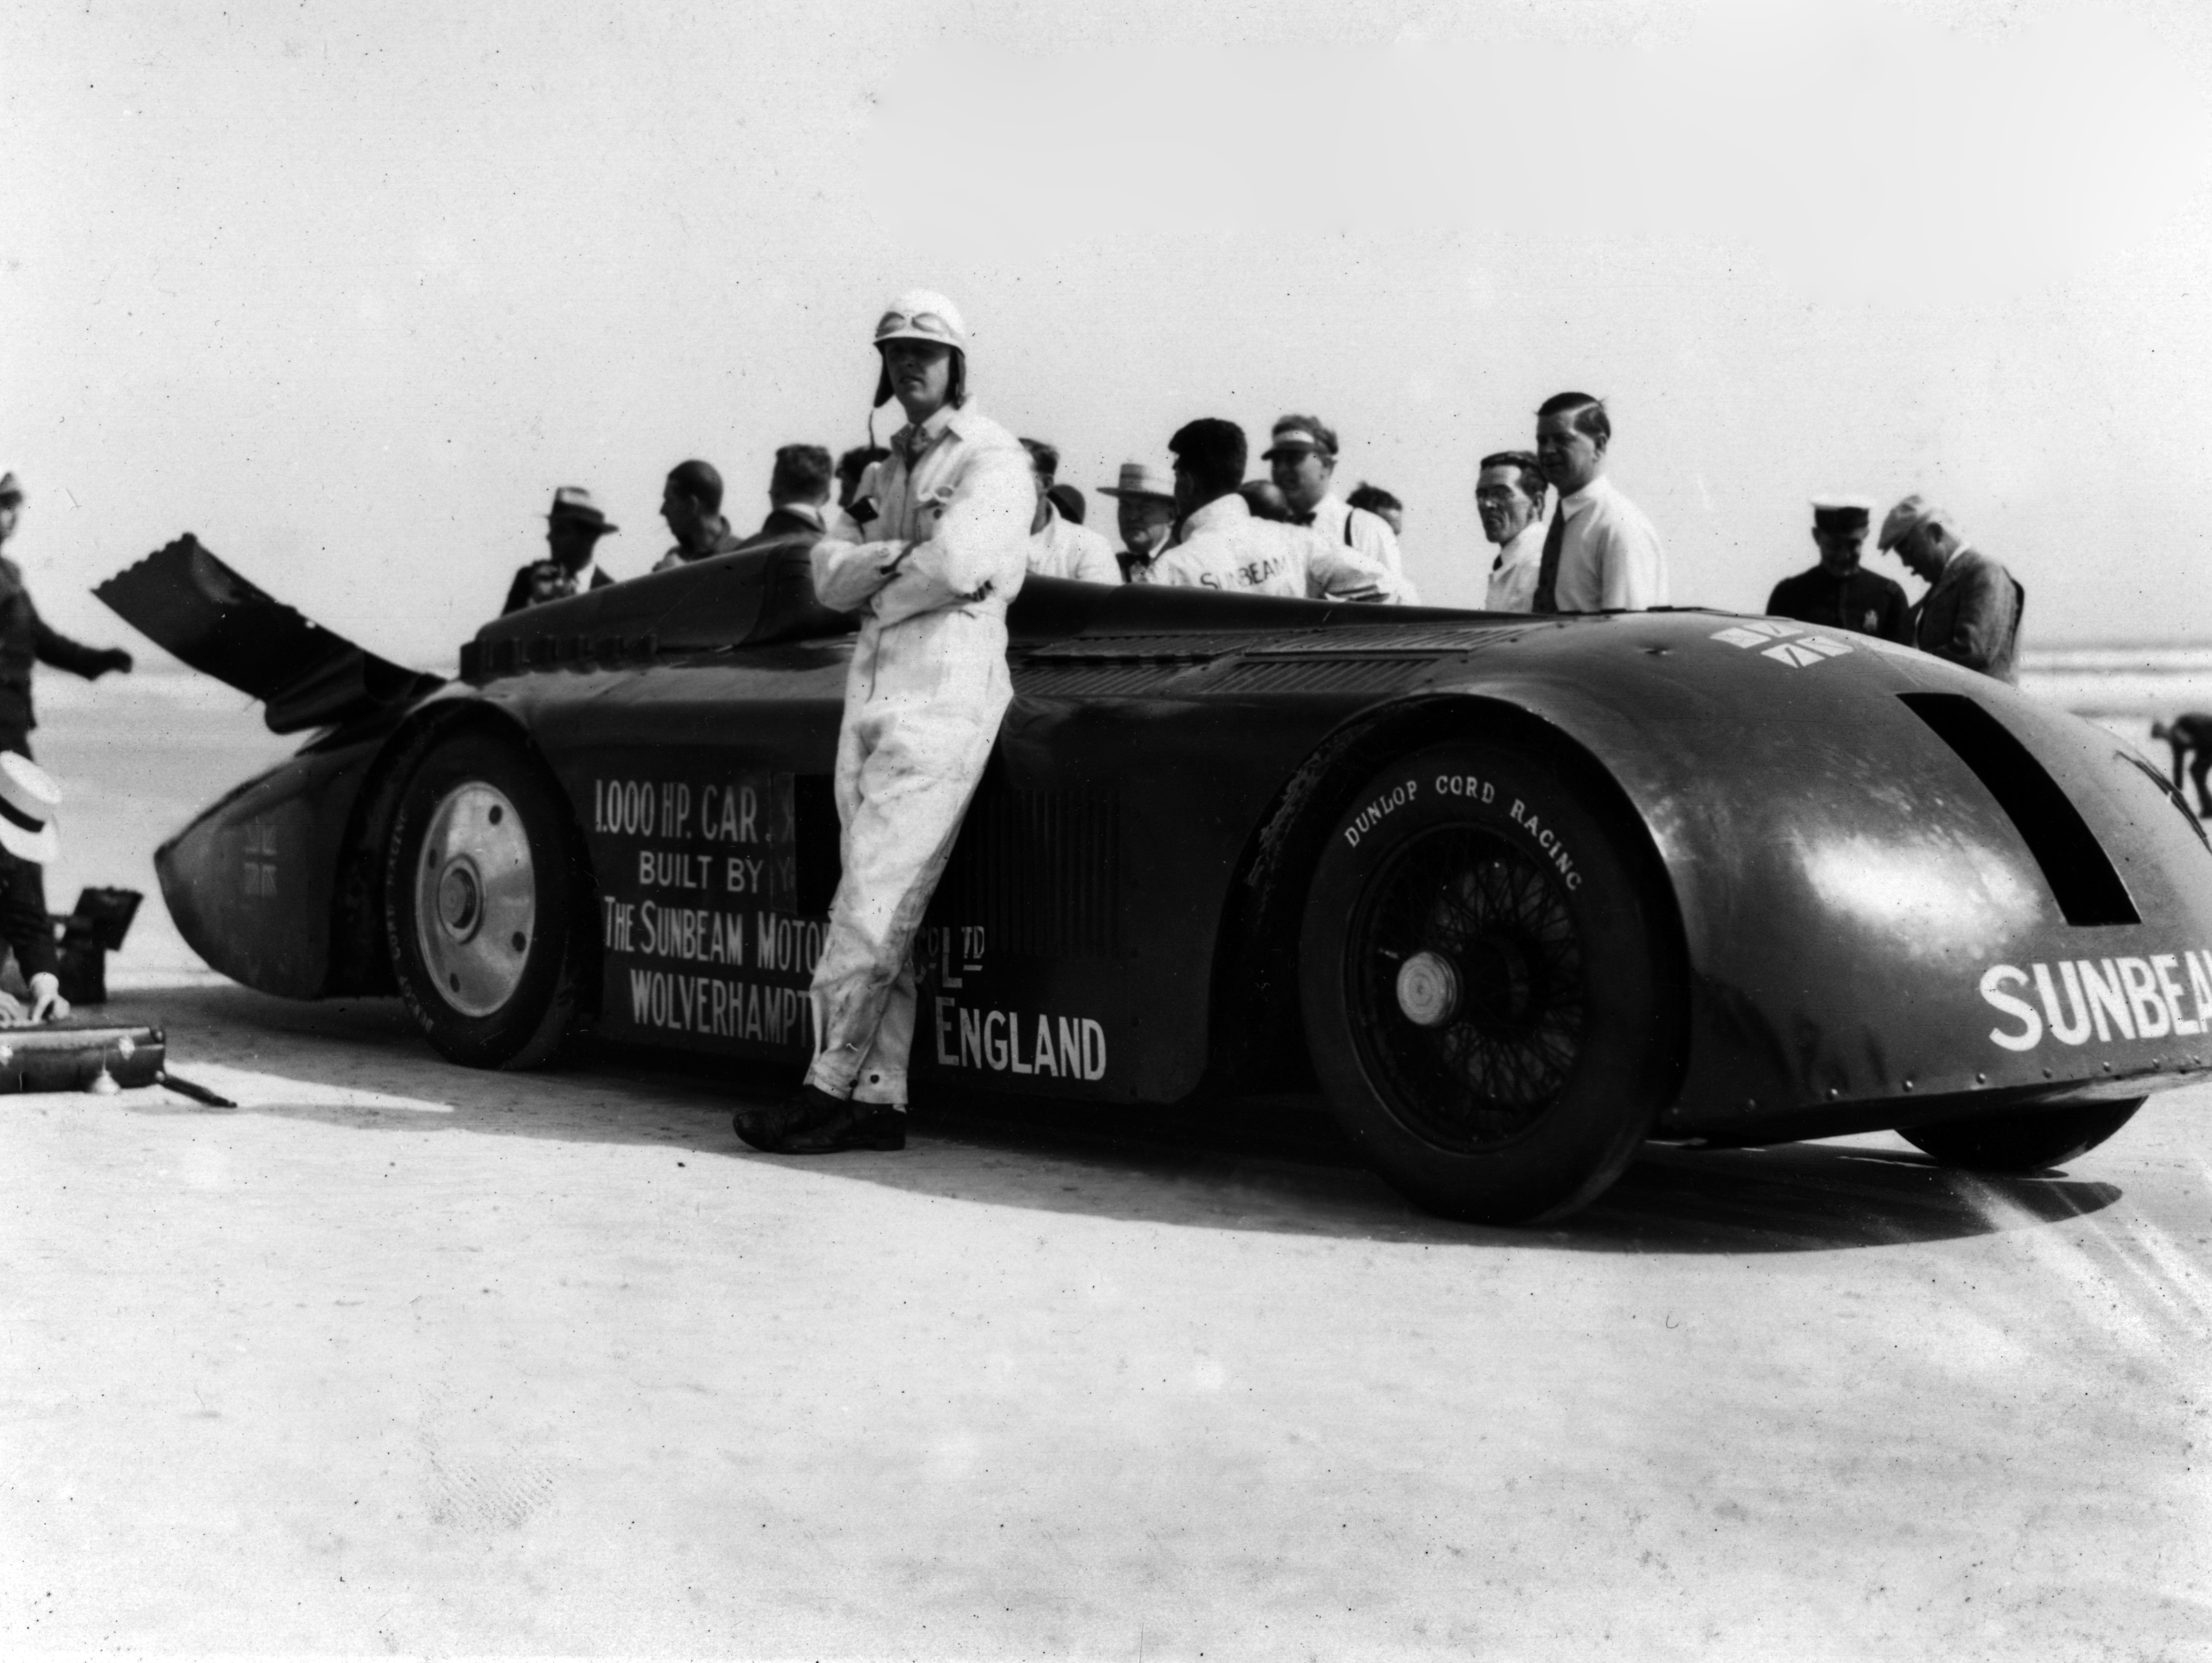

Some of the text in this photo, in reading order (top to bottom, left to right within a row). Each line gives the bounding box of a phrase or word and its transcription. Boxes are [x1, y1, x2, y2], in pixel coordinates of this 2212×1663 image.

[660, 782, 691, 840] HP.
[1344, 780, 1417, 848] DUNLOP
[1435, 775, 1495, 804] CORD
[639, 850, 764, 894] BUILT BY
[604, 895, 634, 953] THE
[639, 900, 743, 966] SUNBEAM
[630, 968, 1106, 1081] WOLVERHAMPT ENGLAND
[1980, 950, 2212, 1052] SUNBEA
